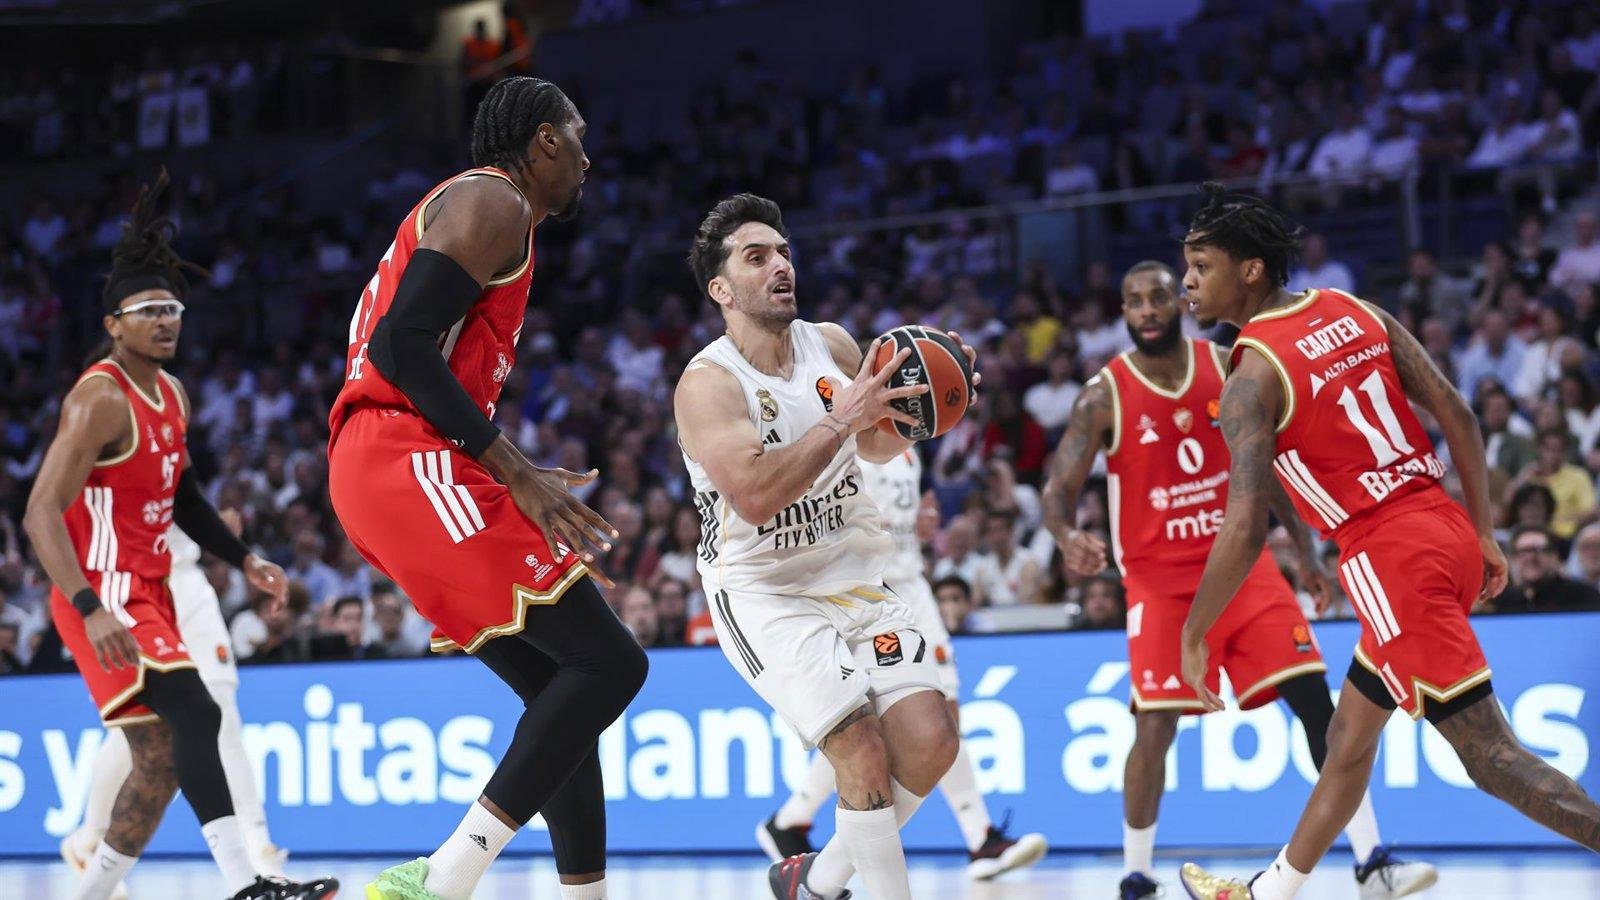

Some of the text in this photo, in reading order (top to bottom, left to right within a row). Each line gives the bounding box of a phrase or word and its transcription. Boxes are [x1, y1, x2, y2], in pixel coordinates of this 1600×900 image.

[1295, 315, 1365, 360] CARTER
[1324, 342, 1390, 381] ALTA BANKA
[901, 364, 930, 438] SPLDIG
[1336, 369, 1416, 468] 11
[1177, 437, 1205, 474] 0
[757, 475, 859, 536] mires
[1166, 509, 1225, 541] mts
[240, 684, 498, 806] nitas
